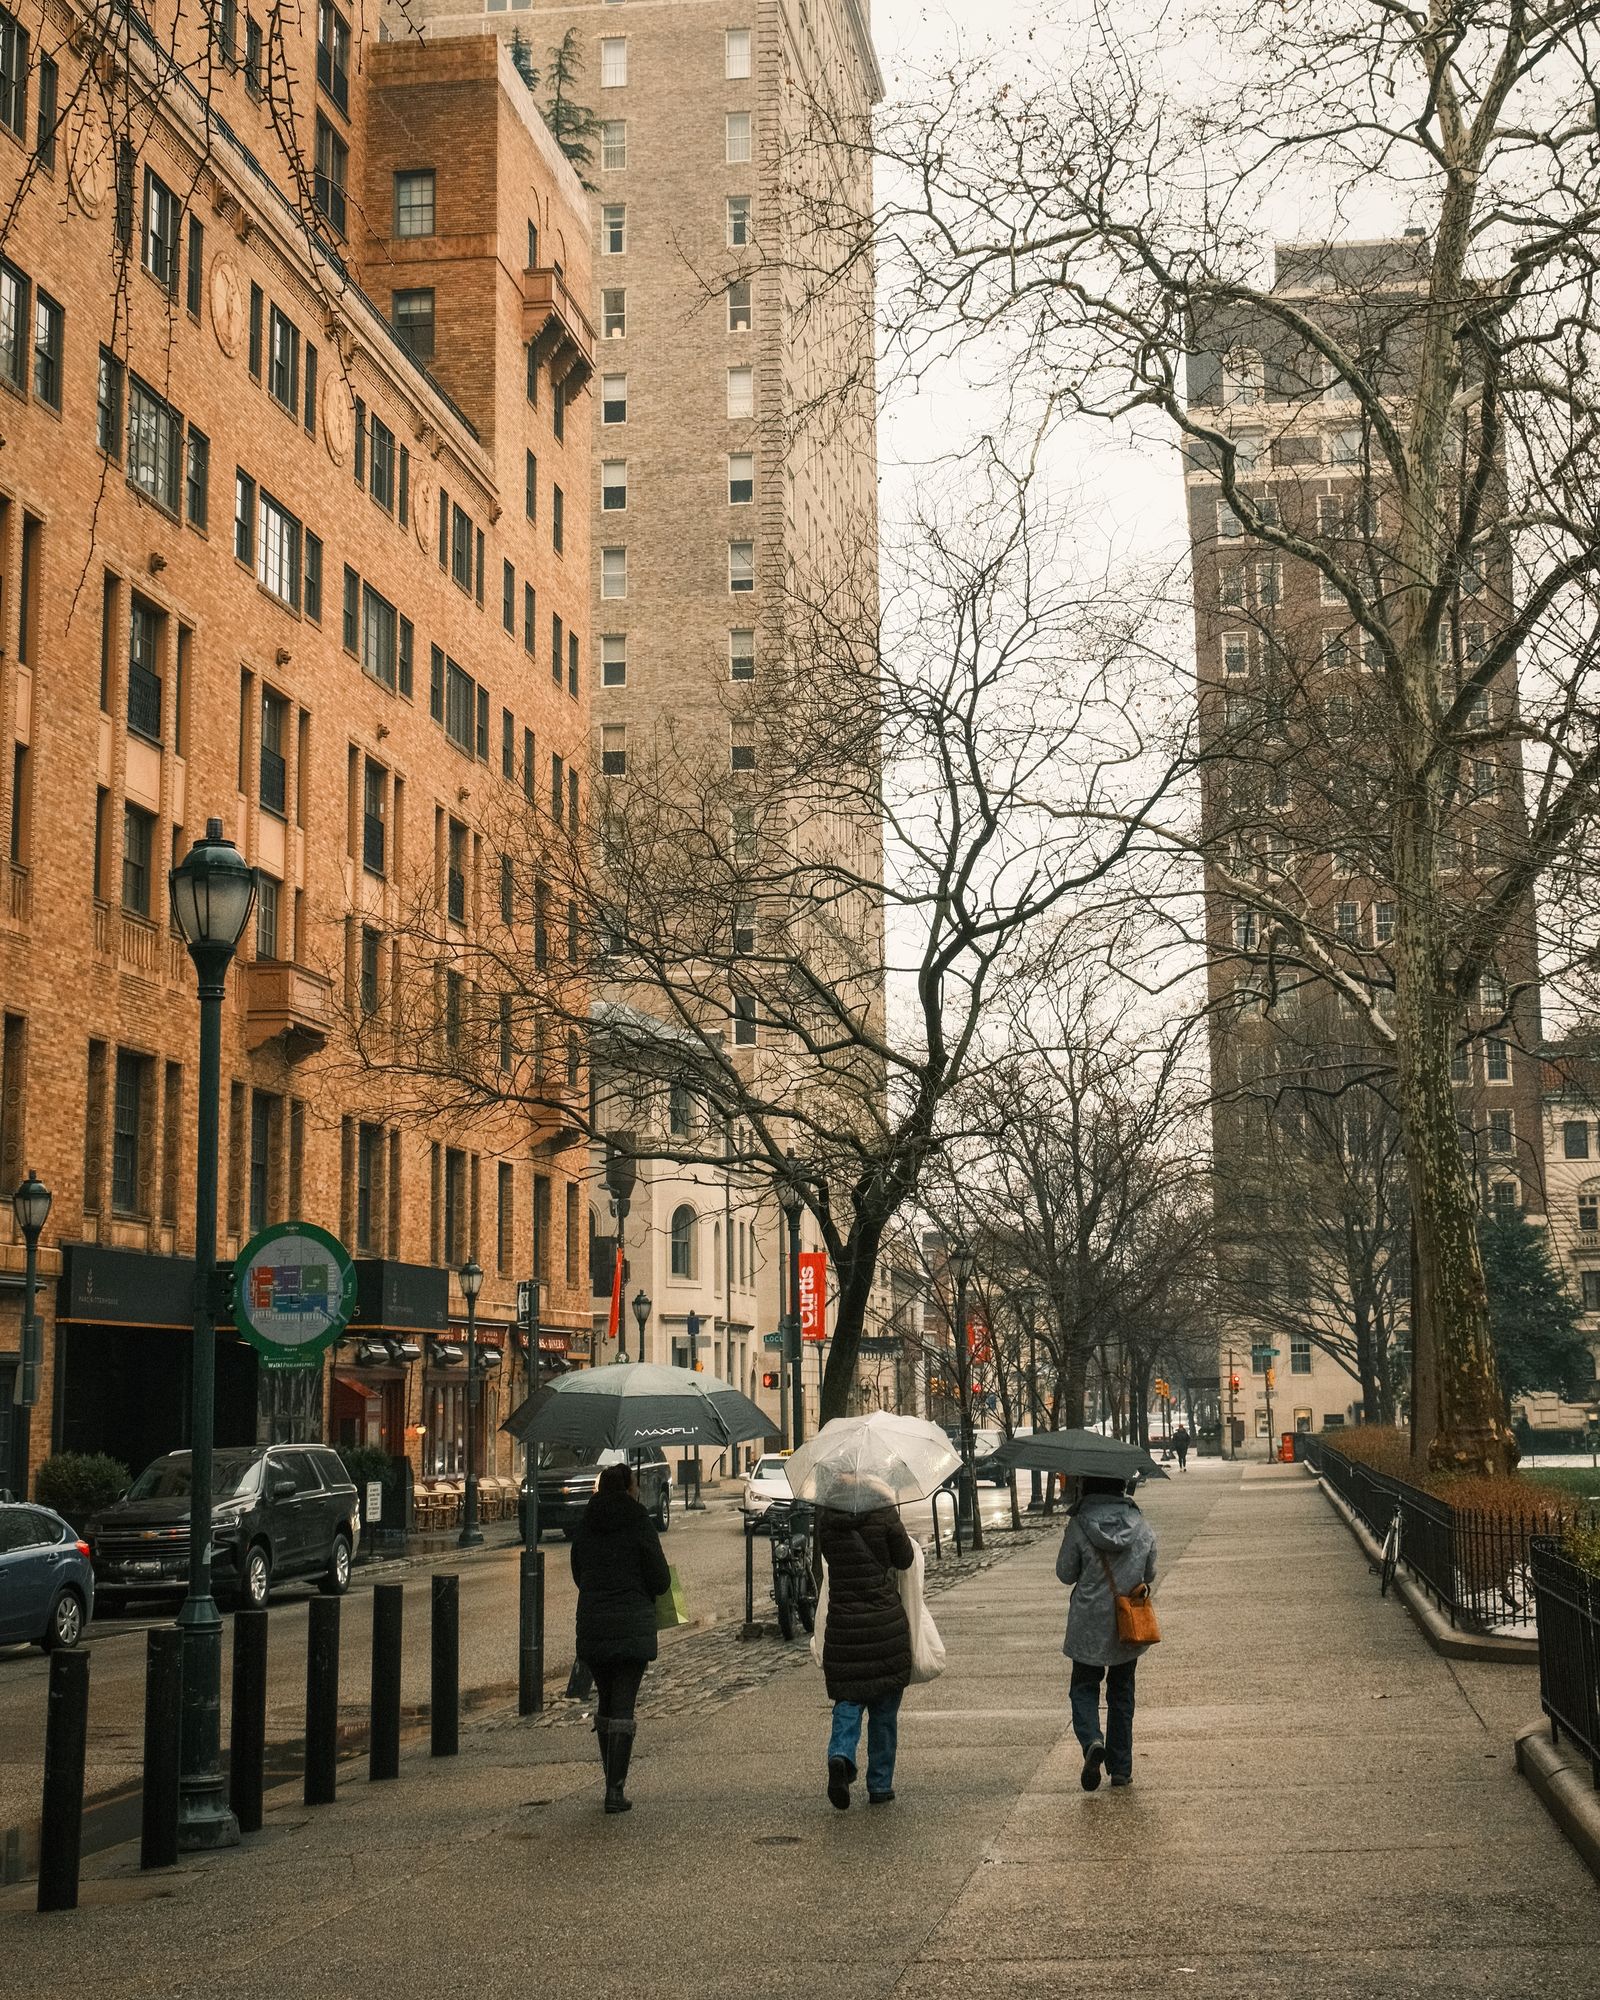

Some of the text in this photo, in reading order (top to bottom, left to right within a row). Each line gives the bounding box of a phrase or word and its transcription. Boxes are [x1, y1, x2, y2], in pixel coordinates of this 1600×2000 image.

[800, 1266, 814, 1329] Curtis
[764, 1335, 784, 1343] LOCU
[634, 1427, 695, 1436] MAXFLI
